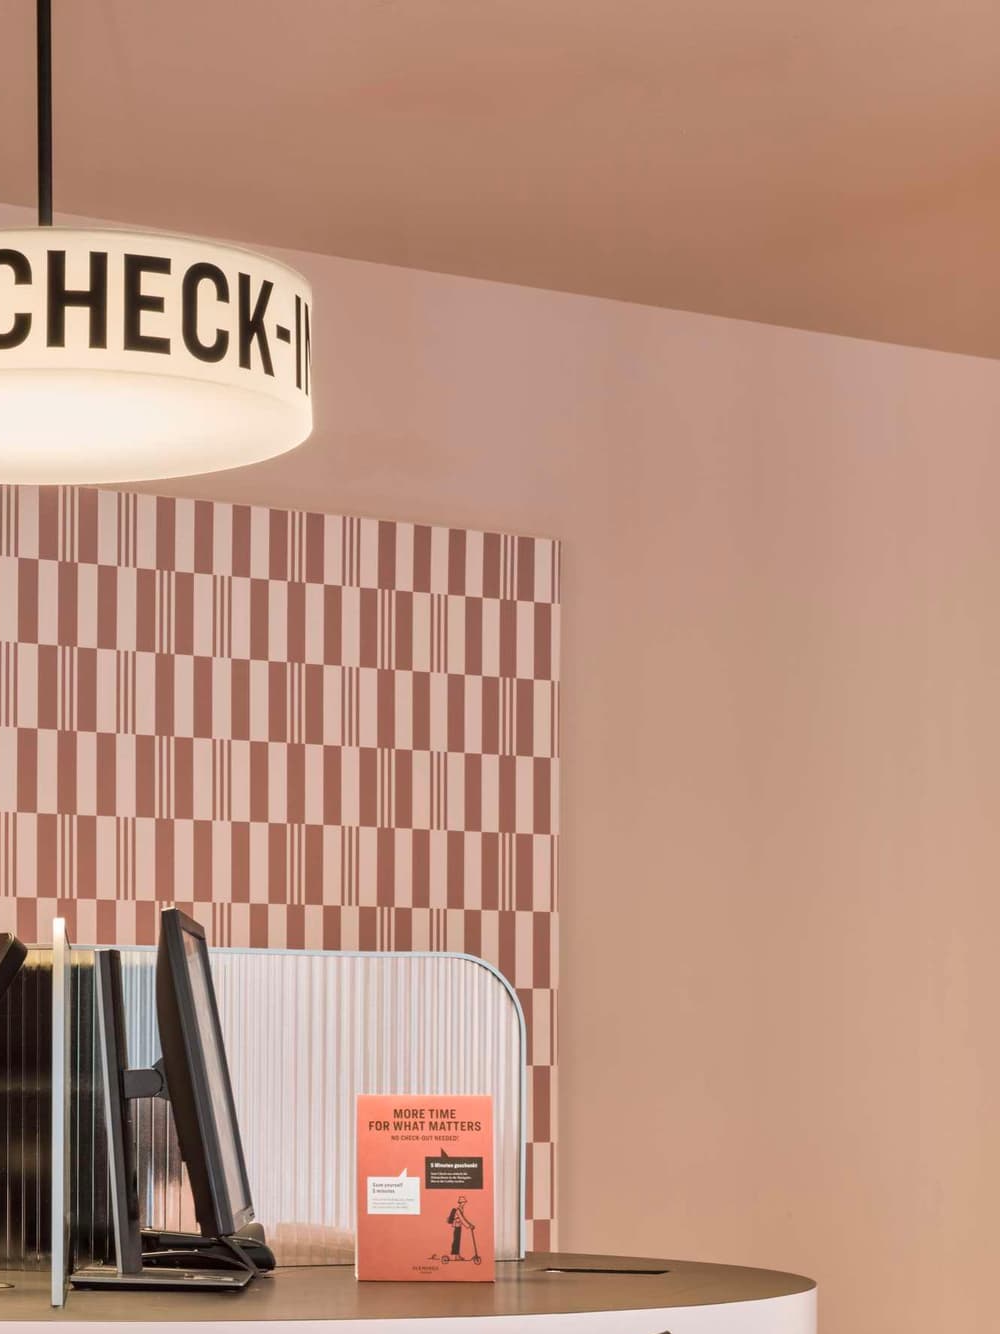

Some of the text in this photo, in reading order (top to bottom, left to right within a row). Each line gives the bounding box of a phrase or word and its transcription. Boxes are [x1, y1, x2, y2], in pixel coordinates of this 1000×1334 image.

[393, 1108, 456, 1119] MORE TIME
[368, 1121, 482, 1132] FOR WHAT MATTERS
